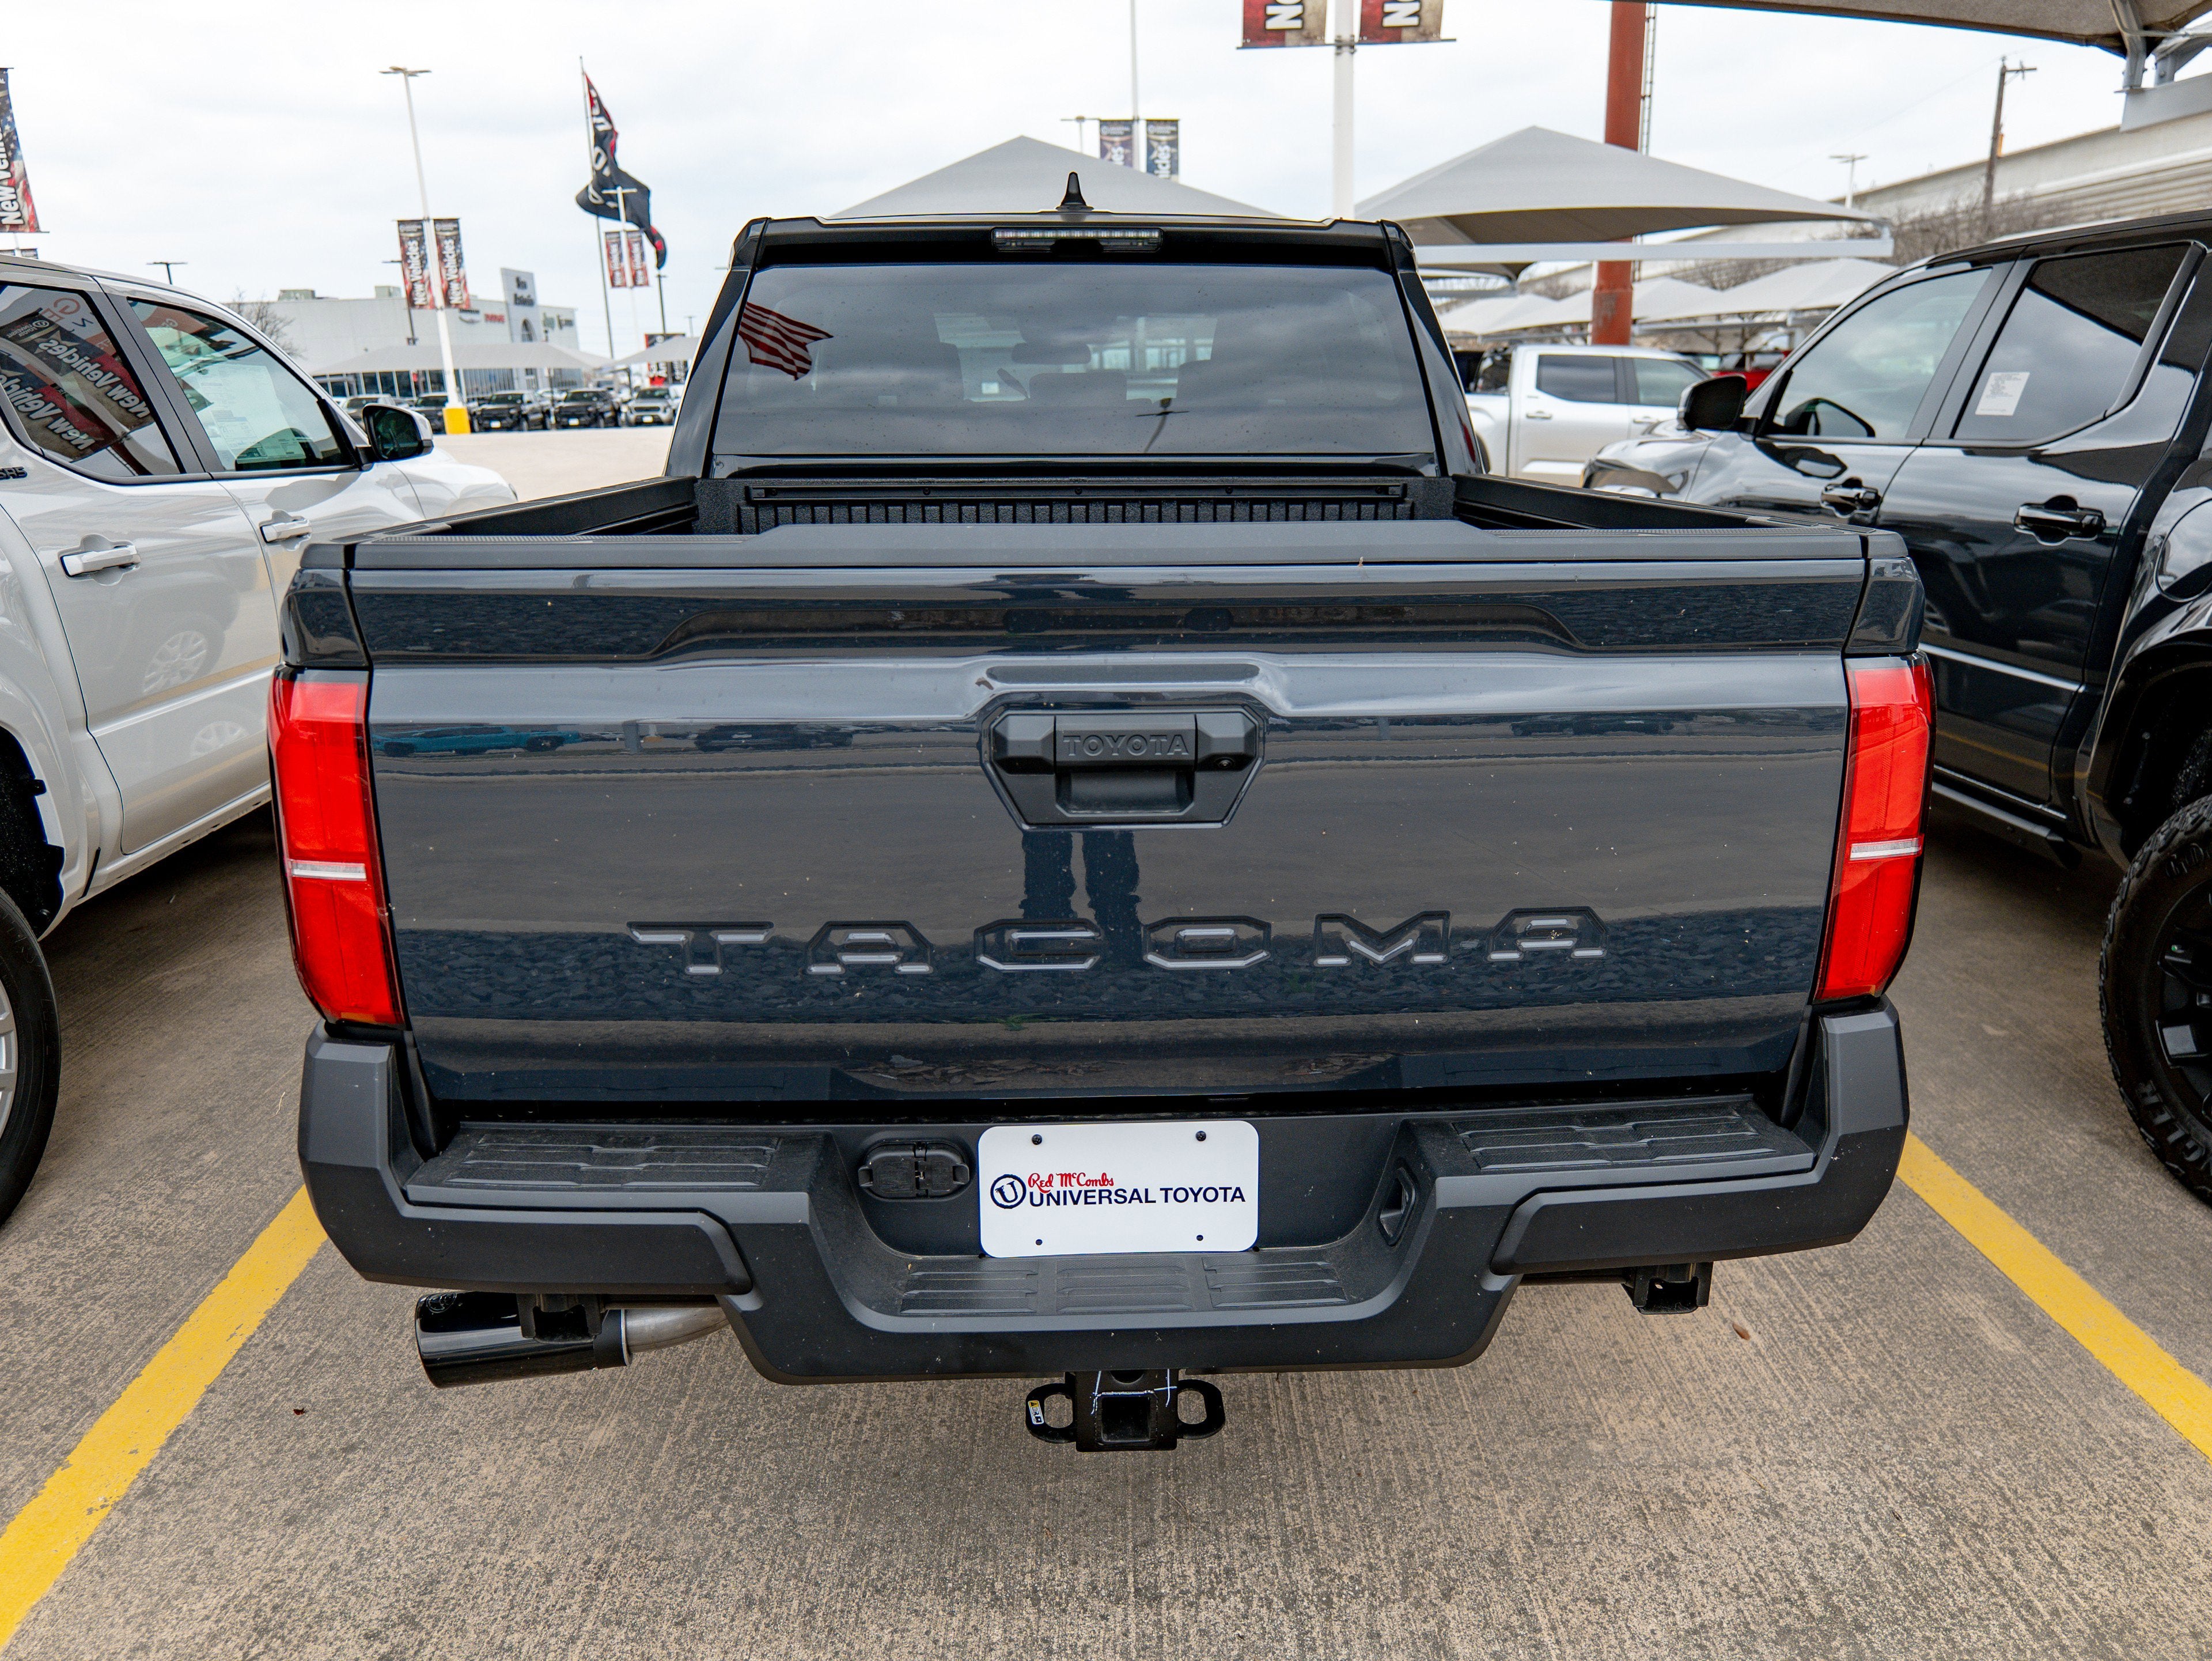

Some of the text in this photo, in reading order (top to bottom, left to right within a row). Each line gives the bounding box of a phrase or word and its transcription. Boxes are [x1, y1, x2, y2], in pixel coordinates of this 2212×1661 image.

[1063, 733, 1190, 756] TOYOTA
[627, 906, 1612, 976] TACOMA
[1028, 1172, 1114, 1193] Red McCombs
[1029, 1186, 1246, 1207] UNIVERSAL TOYOTA
